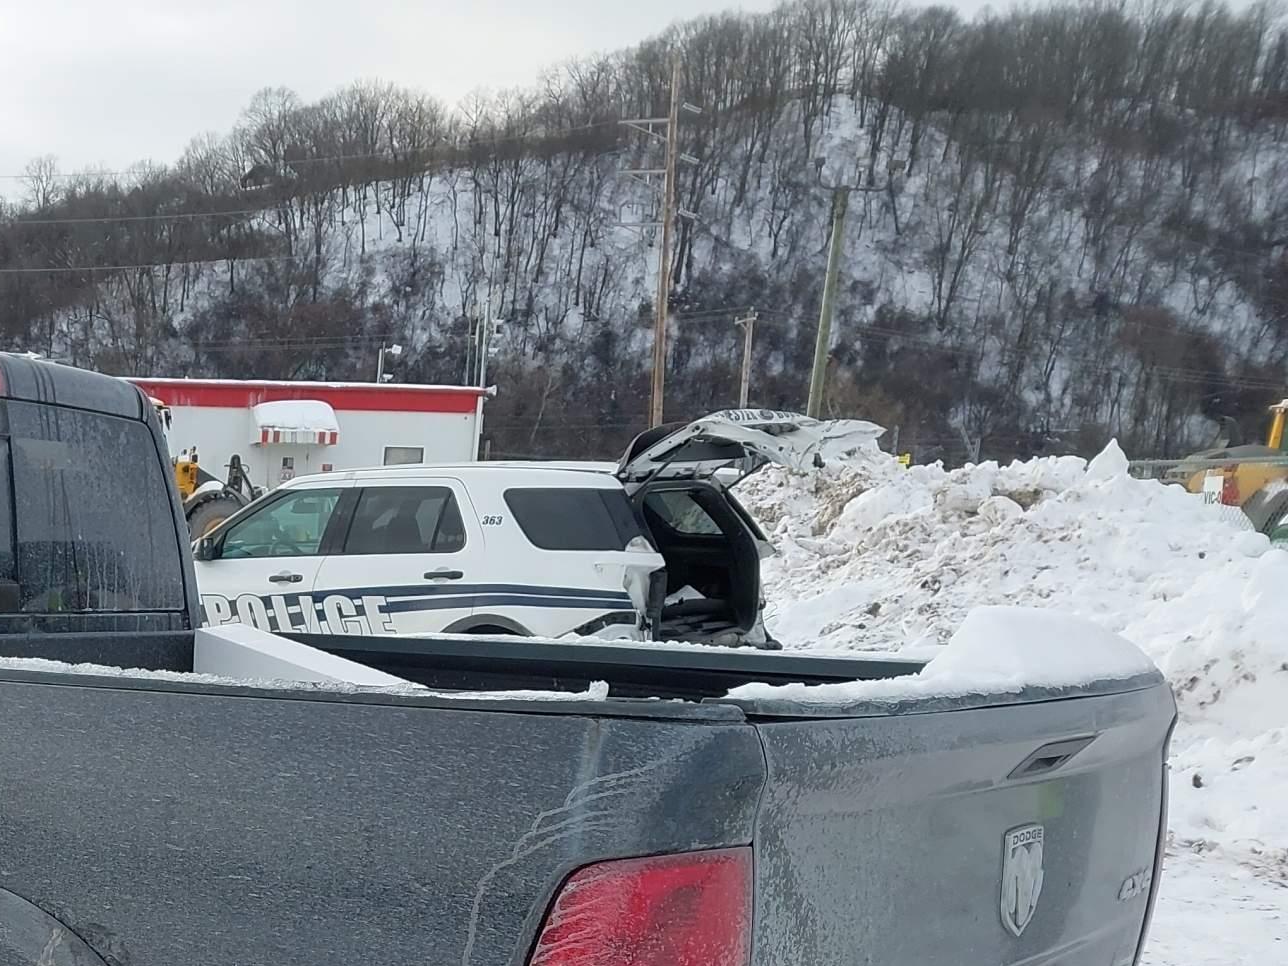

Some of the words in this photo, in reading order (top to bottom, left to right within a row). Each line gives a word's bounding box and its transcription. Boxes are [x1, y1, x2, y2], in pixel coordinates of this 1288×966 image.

[482, 515, 503, 526] 363
[200, 593, 398, 635] POLICE
[1013, 828, 1043, 846] DODGE
